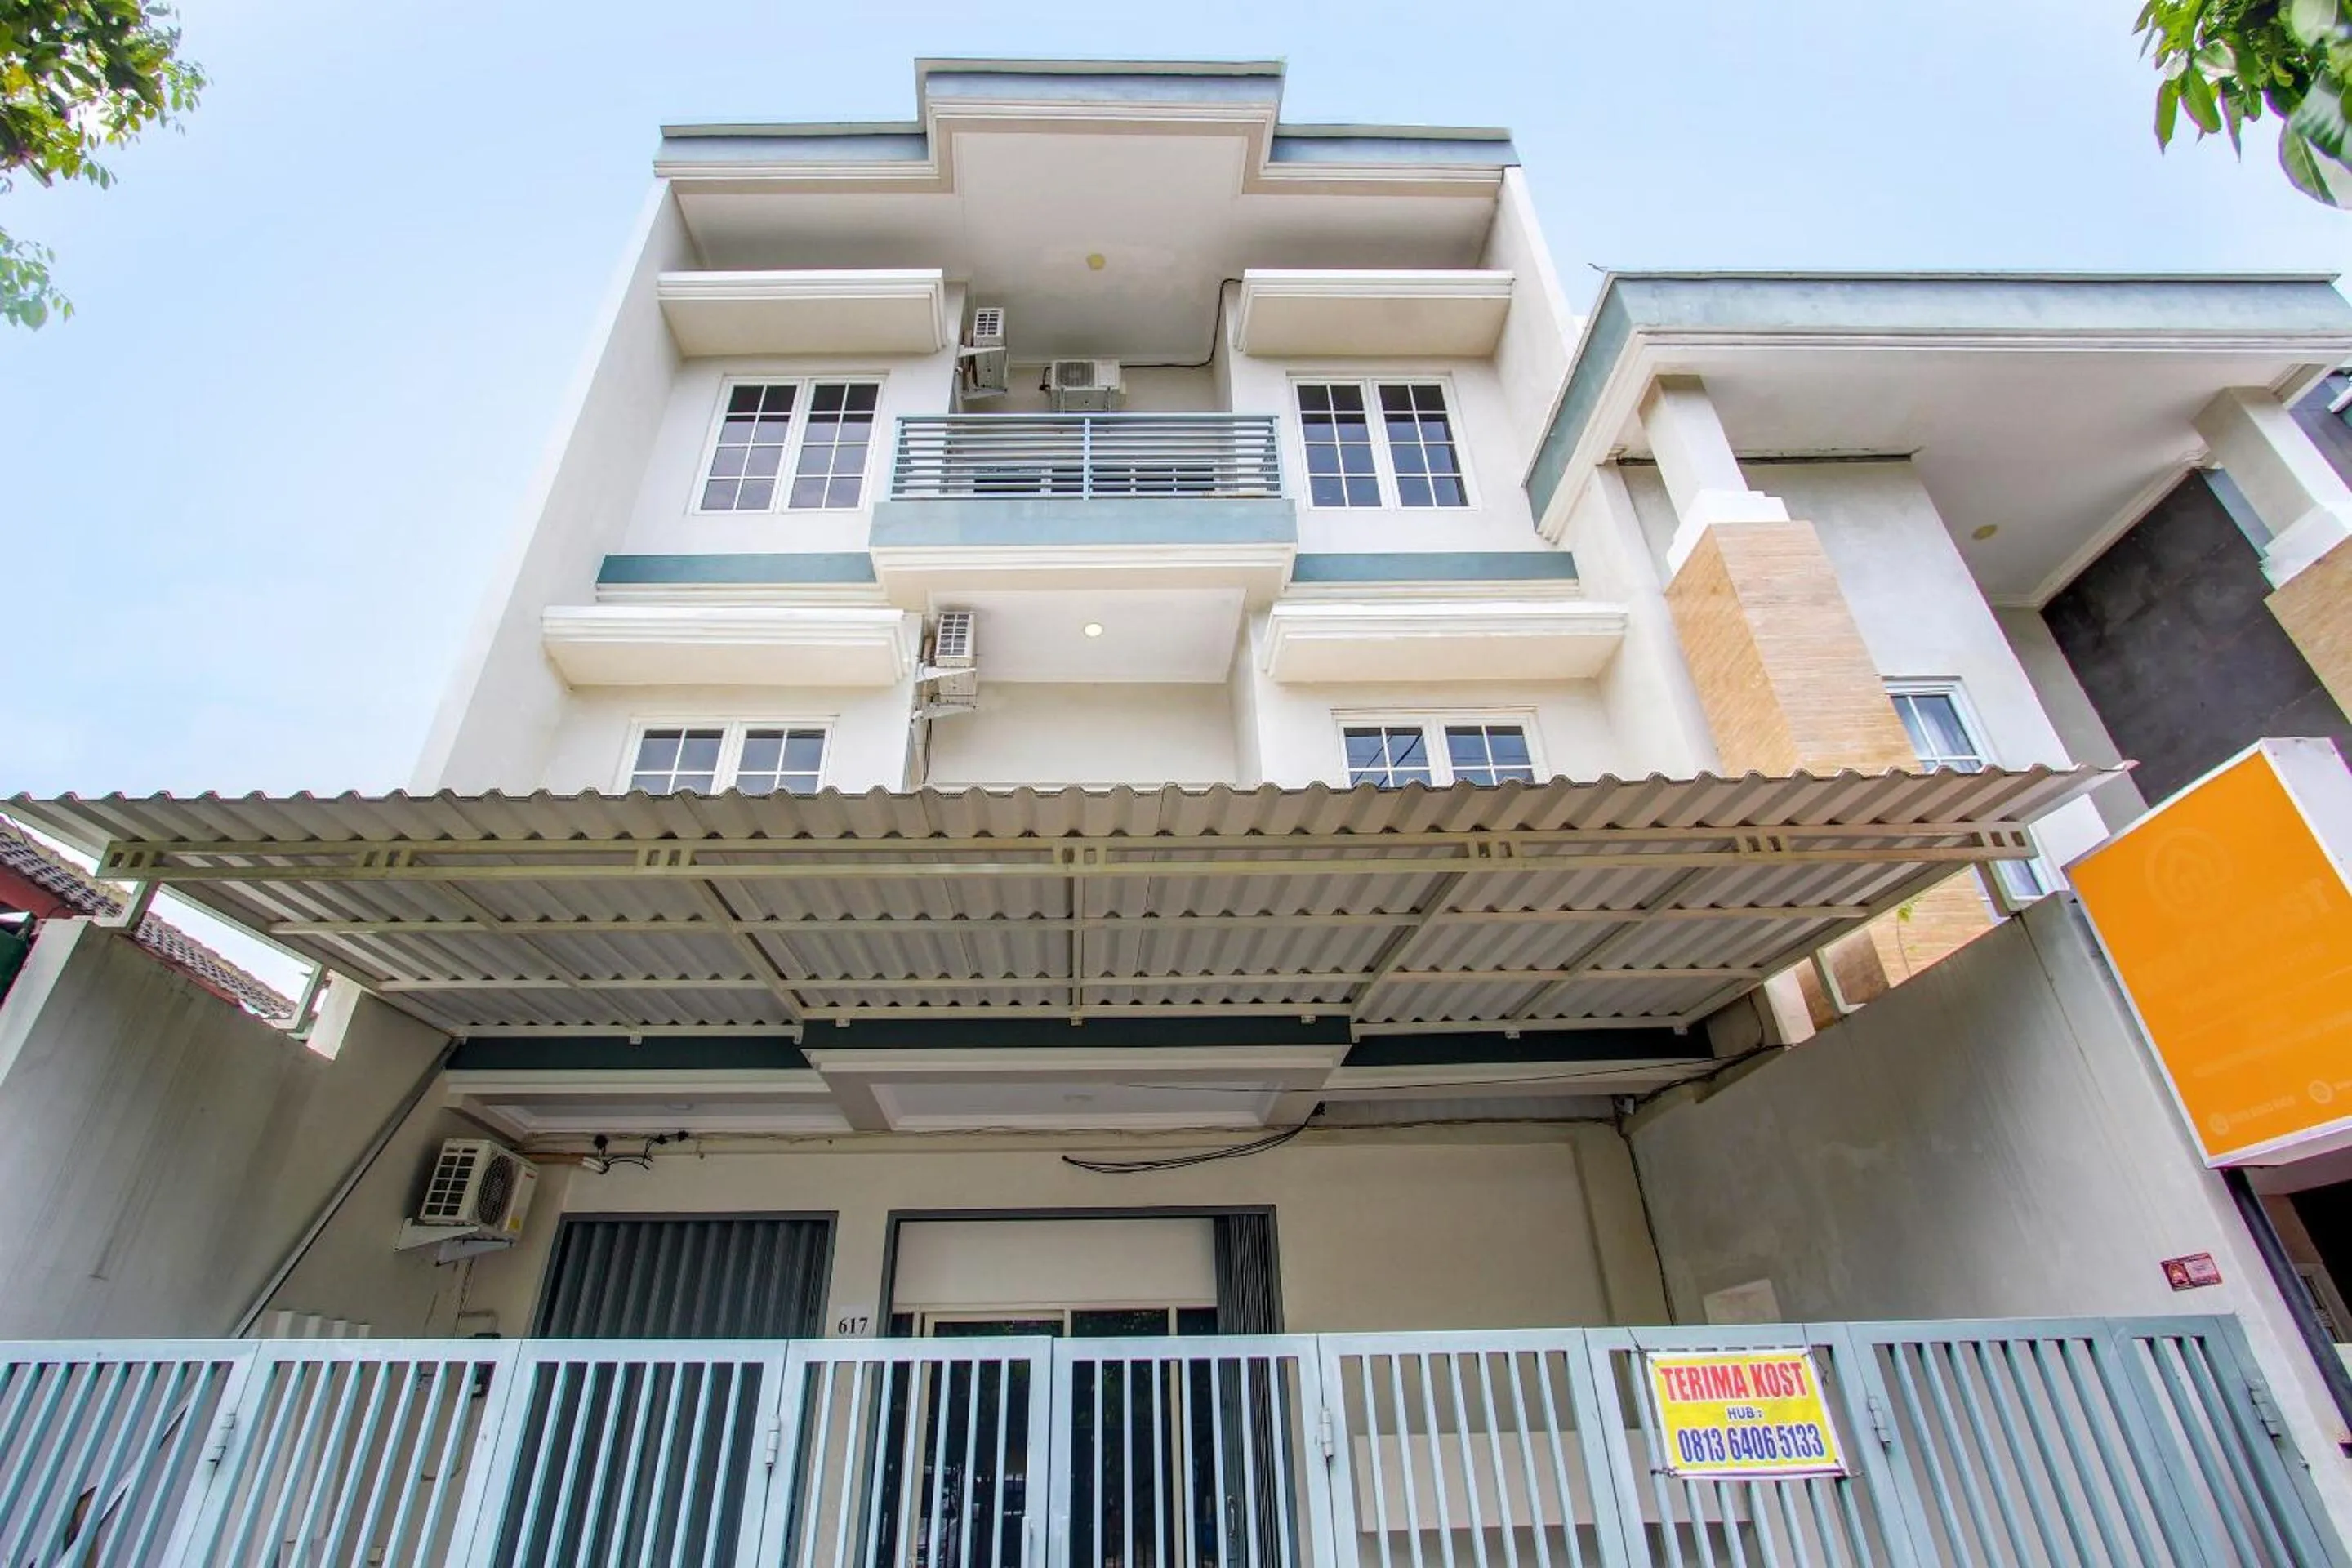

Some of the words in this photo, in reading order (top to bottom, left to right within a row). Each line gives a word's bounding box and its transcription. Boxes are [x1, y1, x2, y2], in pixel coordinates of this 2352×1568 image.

[838, 1316, 868, 1334] 617
[1660, 1365, 1749, 1401] TERIMA
[1749, 1362, 1806, 1397] KOST
[1678, 1428, 1726, 1463] 0813
[1727, 1425, 1777, 1460] 6406
[1775, 1423, 1824, 1458] 5133
